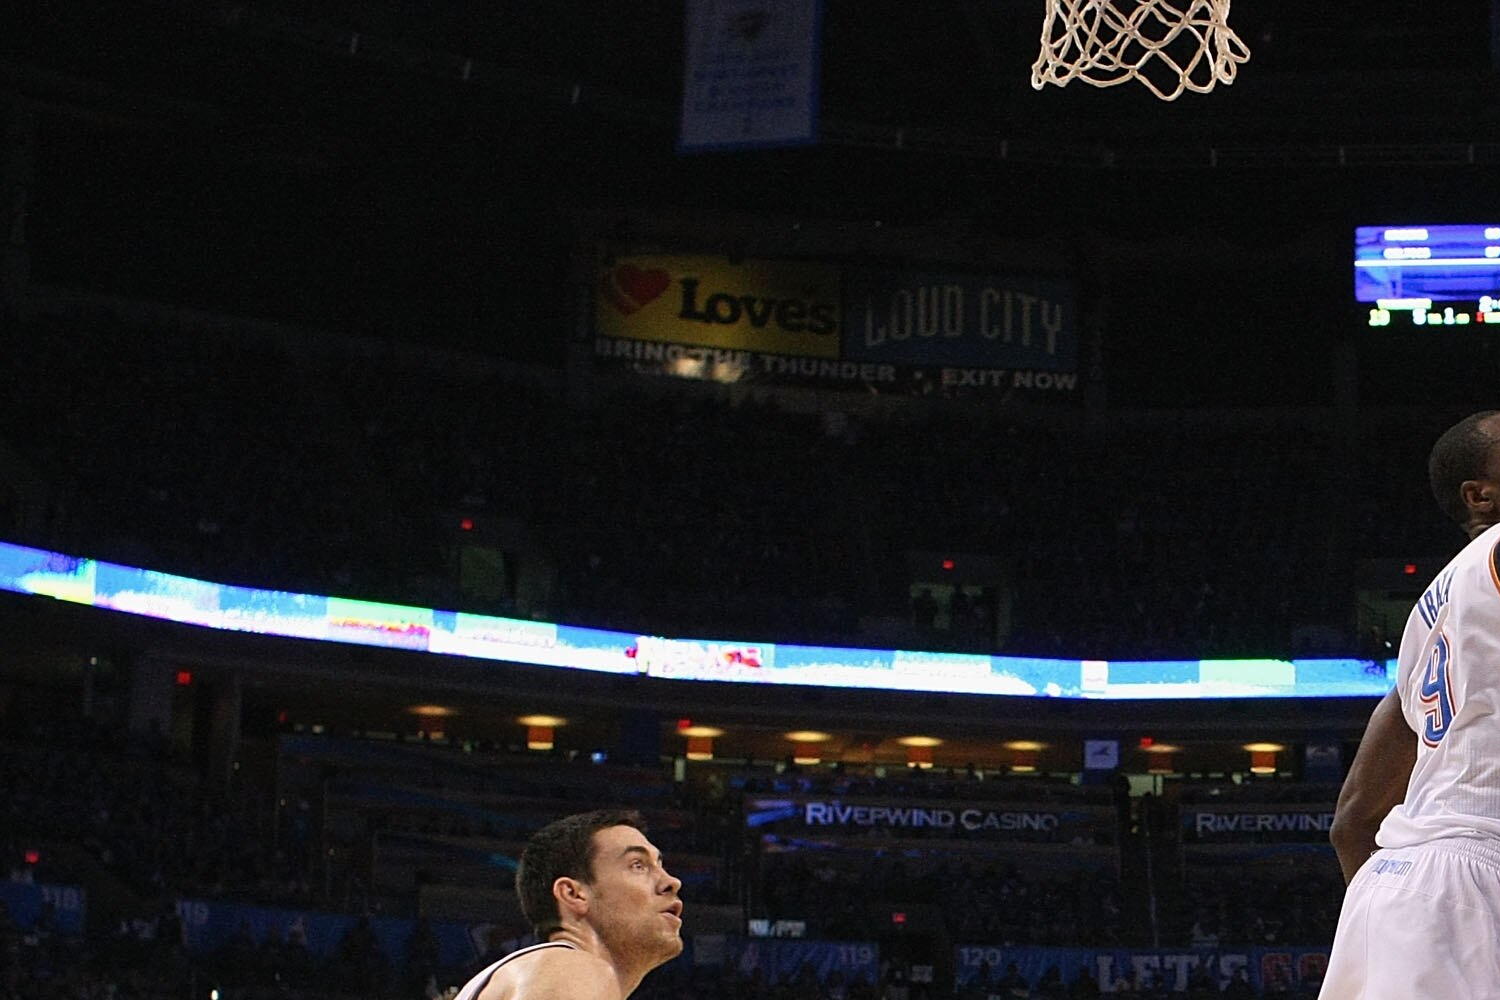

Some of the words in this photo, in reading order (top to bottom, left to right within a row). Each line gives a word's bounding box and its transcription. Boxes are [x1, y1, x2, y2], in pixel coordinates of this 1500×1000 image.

[865, 284, 964, 349] LOUD
[979, 287, 1063, 356] CITY
[762, 354, 897, 383] THUNDER
[942, 367, 1008, 388] EXIT
[1014, 370, 1078, 391] NOW
[1418, 632, 1457, 749] 9
[805, 802, 955, 828] RIVERWIND
[960, 807, 1059, 831] CASINO
[960, 947, 1002, 967] 120
[1097, 953, 1249, 993] LET'S
